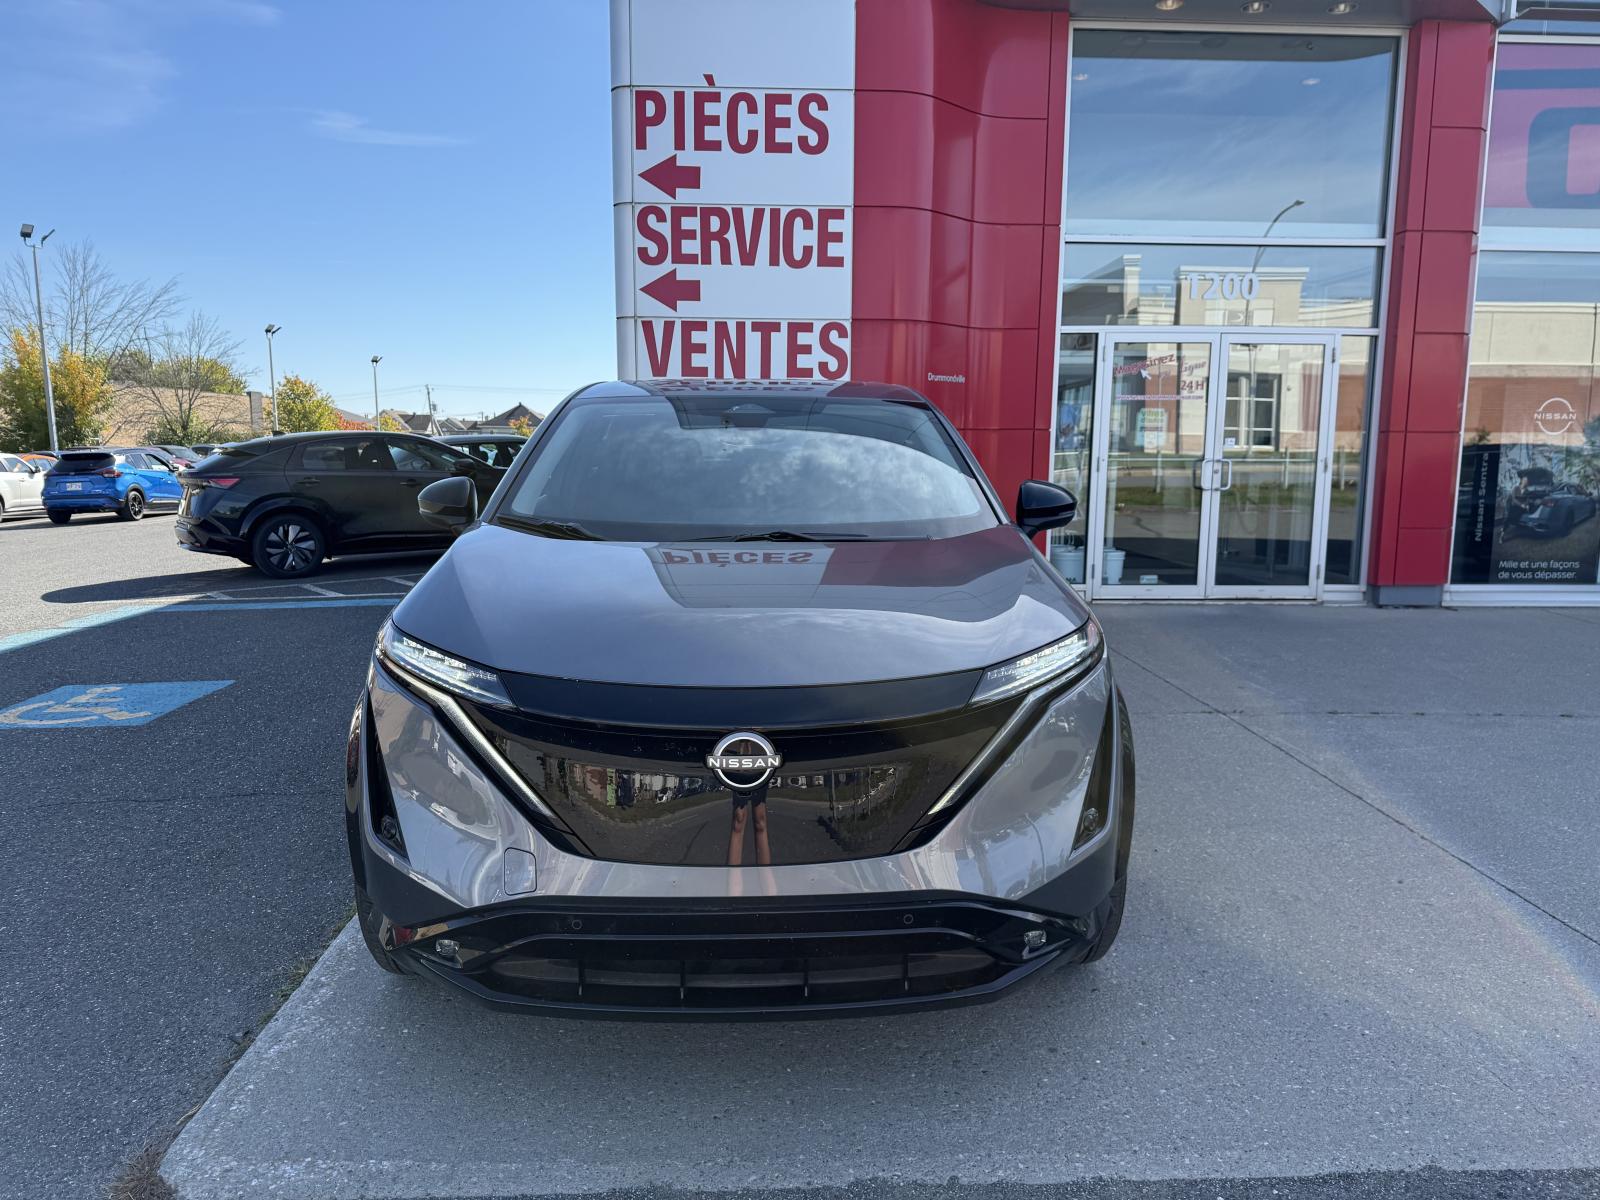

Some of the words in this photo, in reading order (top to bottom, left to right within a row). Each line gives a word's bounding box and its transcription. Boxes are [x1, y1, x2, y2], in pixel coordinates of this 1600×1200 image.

[634, 74, 829, 155] PIÈCES
[637, 205, 845, 269] SERVICE
[1188, 272, 1259, 300] 1200
[641, 320, 849, 381] VENTES
[927, 372, 966, 384] Drummondville
[1534, 412, 1577, 420] NISSAN
[1478, 452, 1489, 497] Sentra
[1474, 499, 1485, 542] Nissan
[1498, 571, 1510, 579] de
[1511, 571, 1533, 579] vous
[1499, 560, 1519, 569] Mille
[1520, 561, 1529, 569] et
[1531, 561, 1548, 569] une
[1550, 560, 1580, 570] façons
[709, 757, 779, 768] NISSAN
